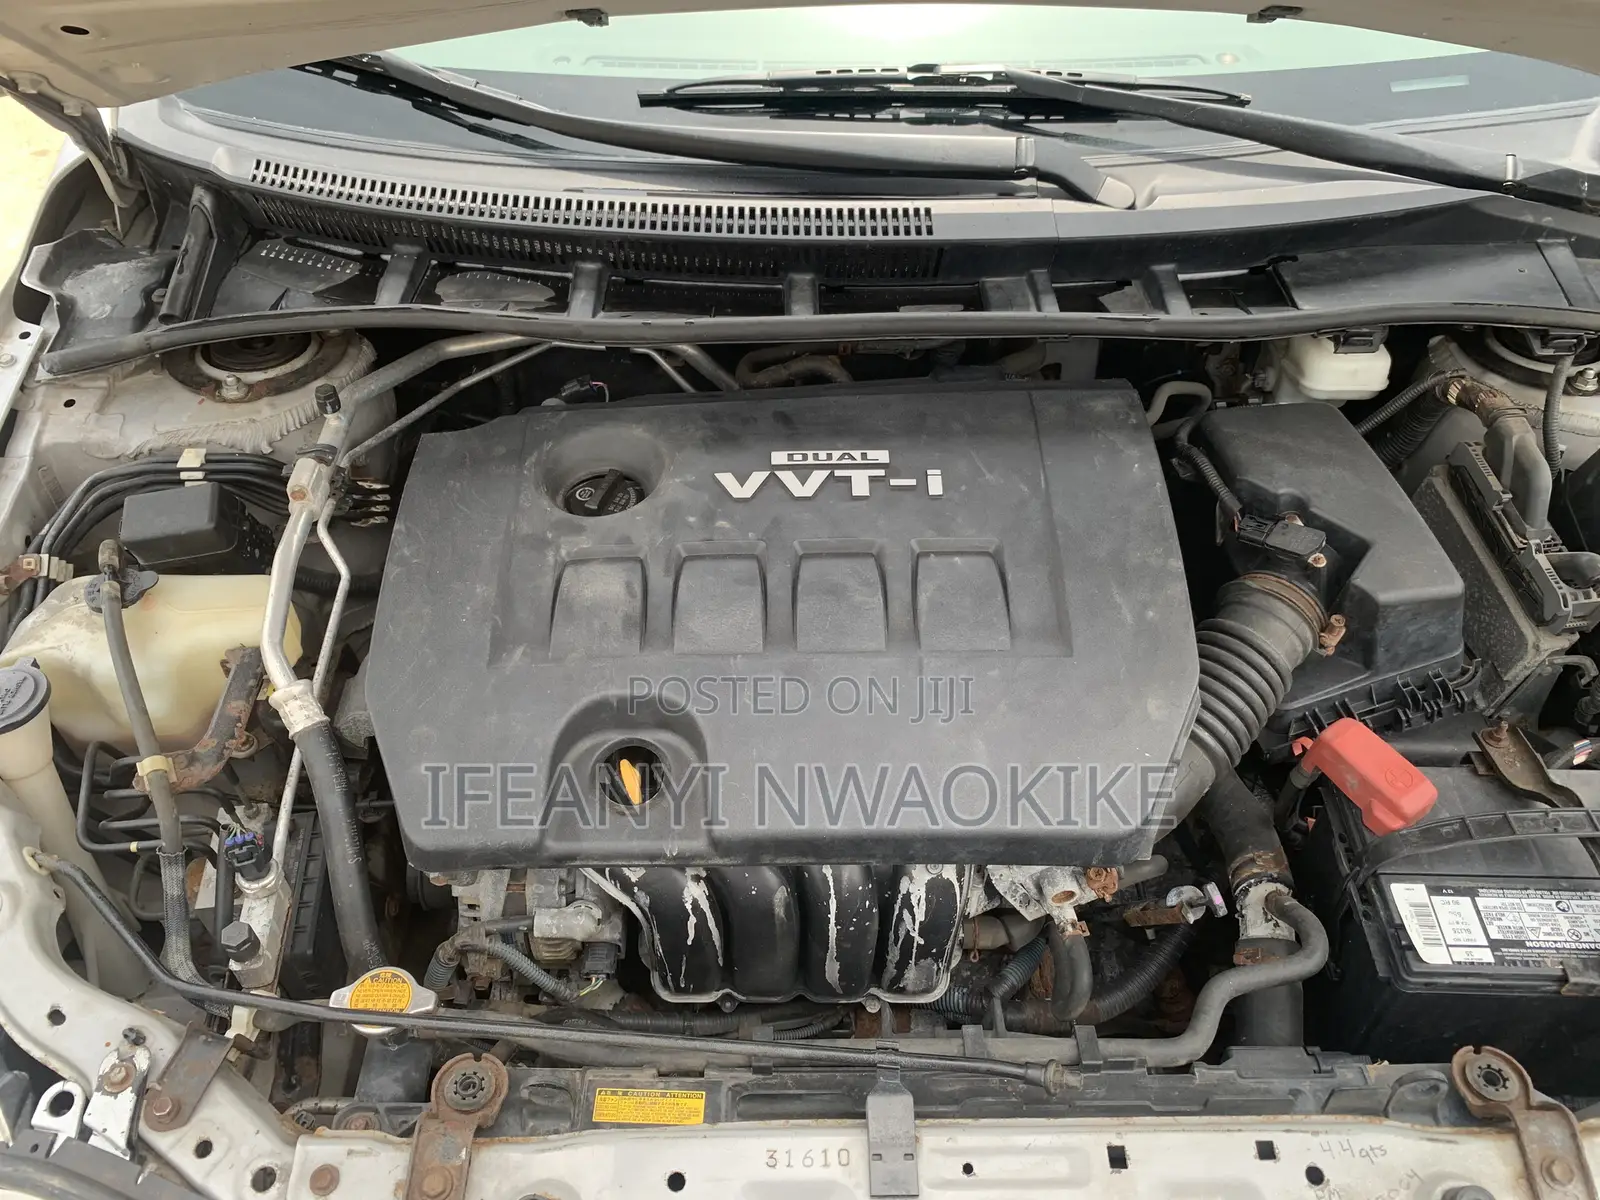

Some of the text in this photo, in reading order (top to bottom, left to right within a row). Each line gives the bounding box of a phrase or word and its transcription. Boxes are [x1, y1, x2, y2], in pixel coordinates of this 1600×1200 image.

[783, 451, 882, 463] DUAL
[713, 469, 944, 499] VVT-i
[627, 1090, 661, 1098] CAUTION
[765, 1148, 851, 1169] 31610
